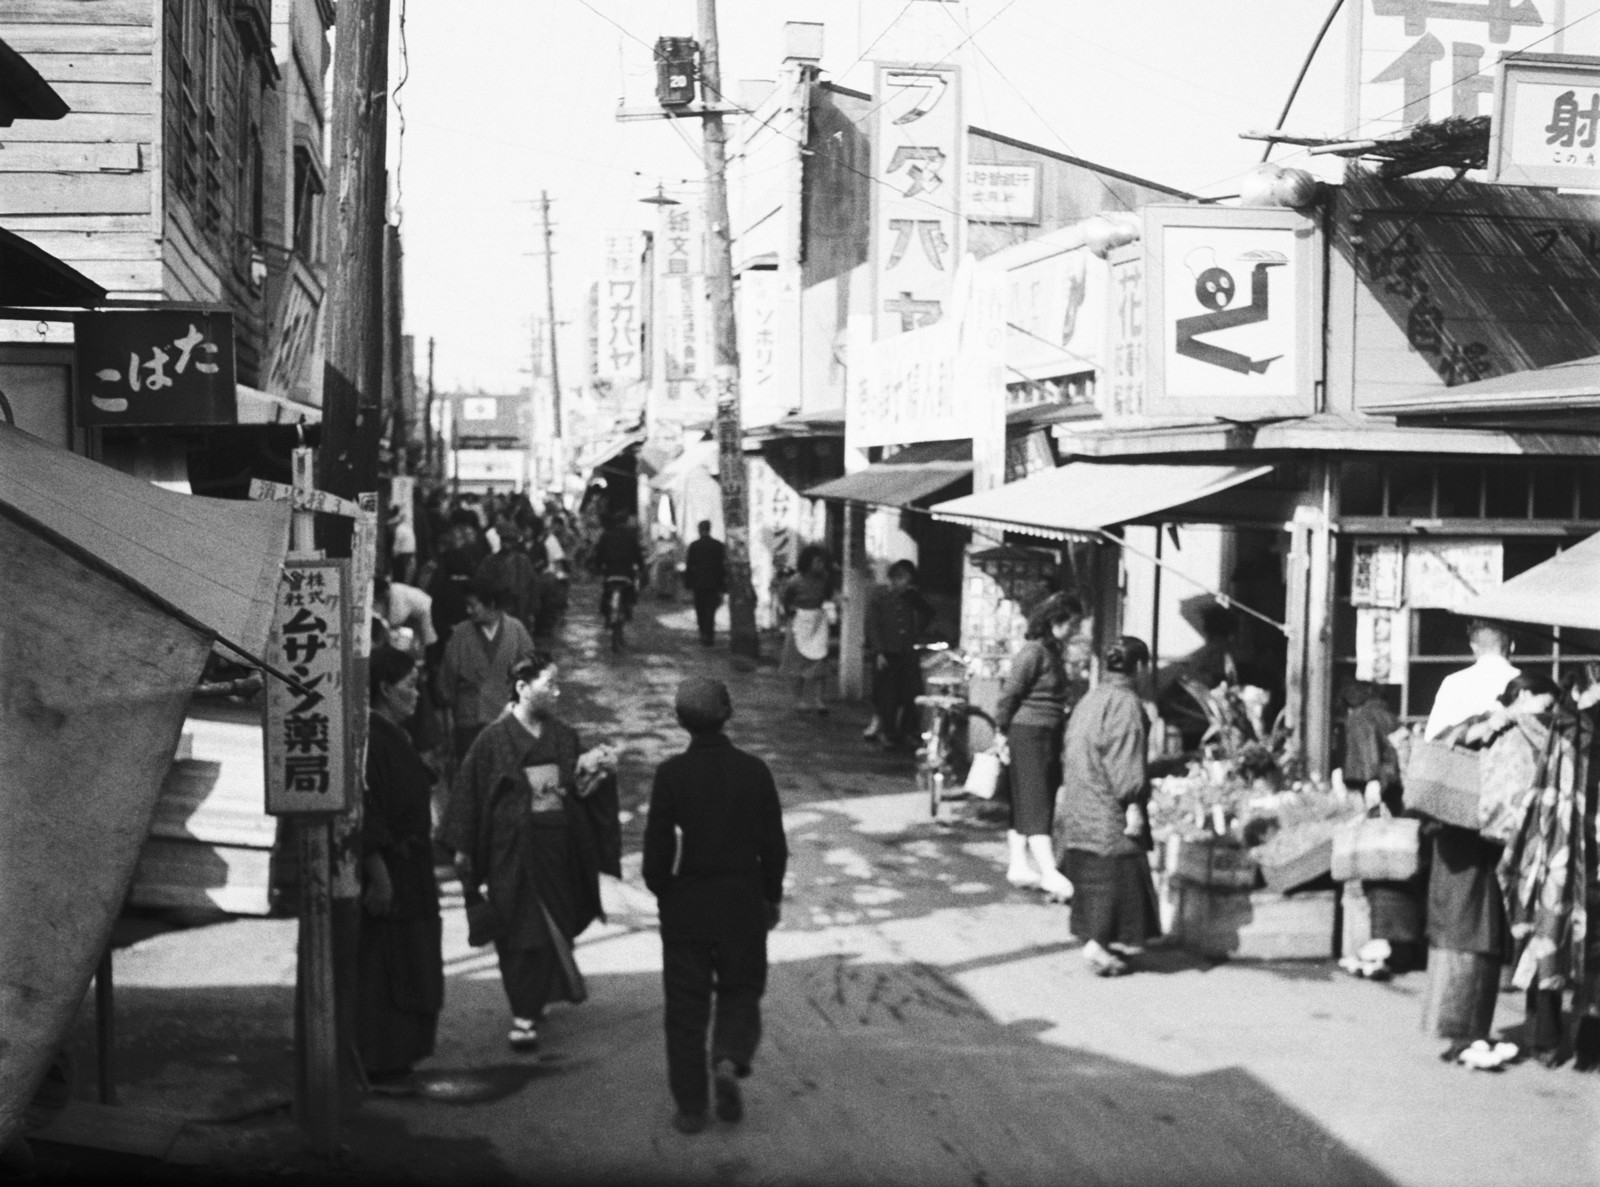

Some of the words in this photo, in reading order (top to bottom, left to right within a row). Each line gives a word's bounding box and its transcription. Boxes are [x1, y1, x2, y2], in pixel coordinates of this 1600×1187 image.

[1545, 90, 1600, 148] 射
[91, 323, 219, 412] たばこ
[608, 280, 637, 372] ワカバヤ
